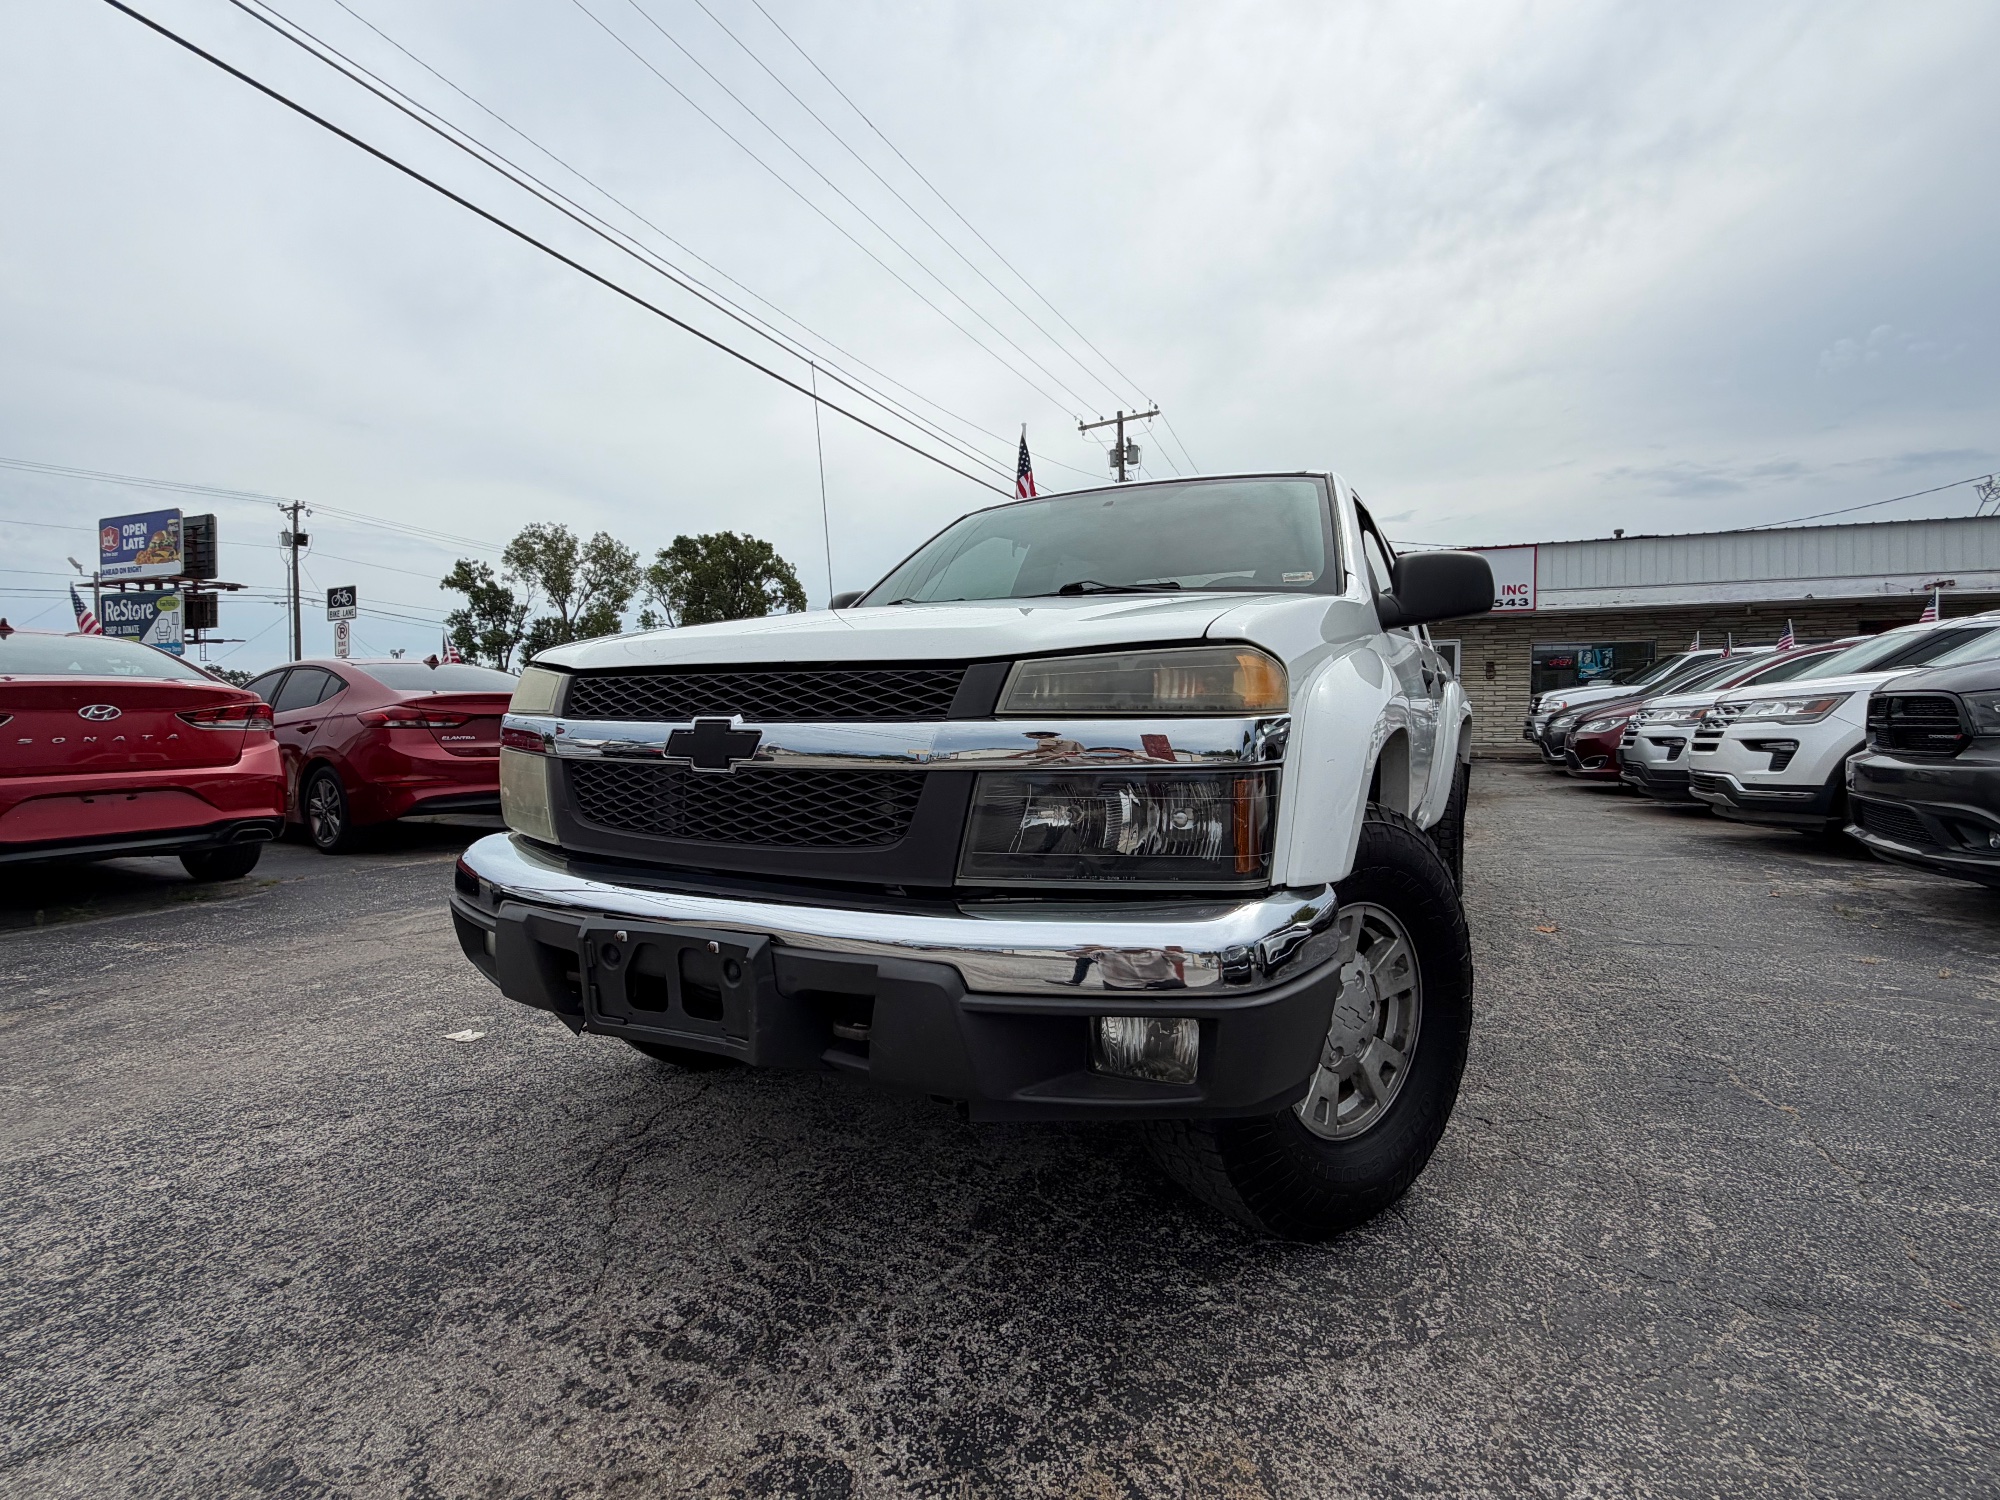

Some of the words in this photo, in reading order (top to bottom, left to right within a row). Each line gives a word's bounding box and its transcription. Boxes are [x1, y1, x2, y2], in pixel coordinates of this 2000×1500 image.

[123, 522, 147, 536] OPEN
[123, 537, 145, 550] LATE
[102, 568, 118, 576] AHEAD
[119, 567, 126, 575] ON
[127, 566, 142, 574] RIGHT
[1502, 584, 1528, 595] INC
[1493, 598, 1529, 607] 543
[105, 599, 154, 621] ReStore
[330, 610, 340, 618] BIKE
[343, 609, 354, 617] LANE
[105, 626, 117, 635] SHOP
[118, 625, 122, 634] &
[123, 624, 140, 634] DONATE
[1548, 658, 1573, 666] OPEN
[16, 733, 179, 745] SONATA
